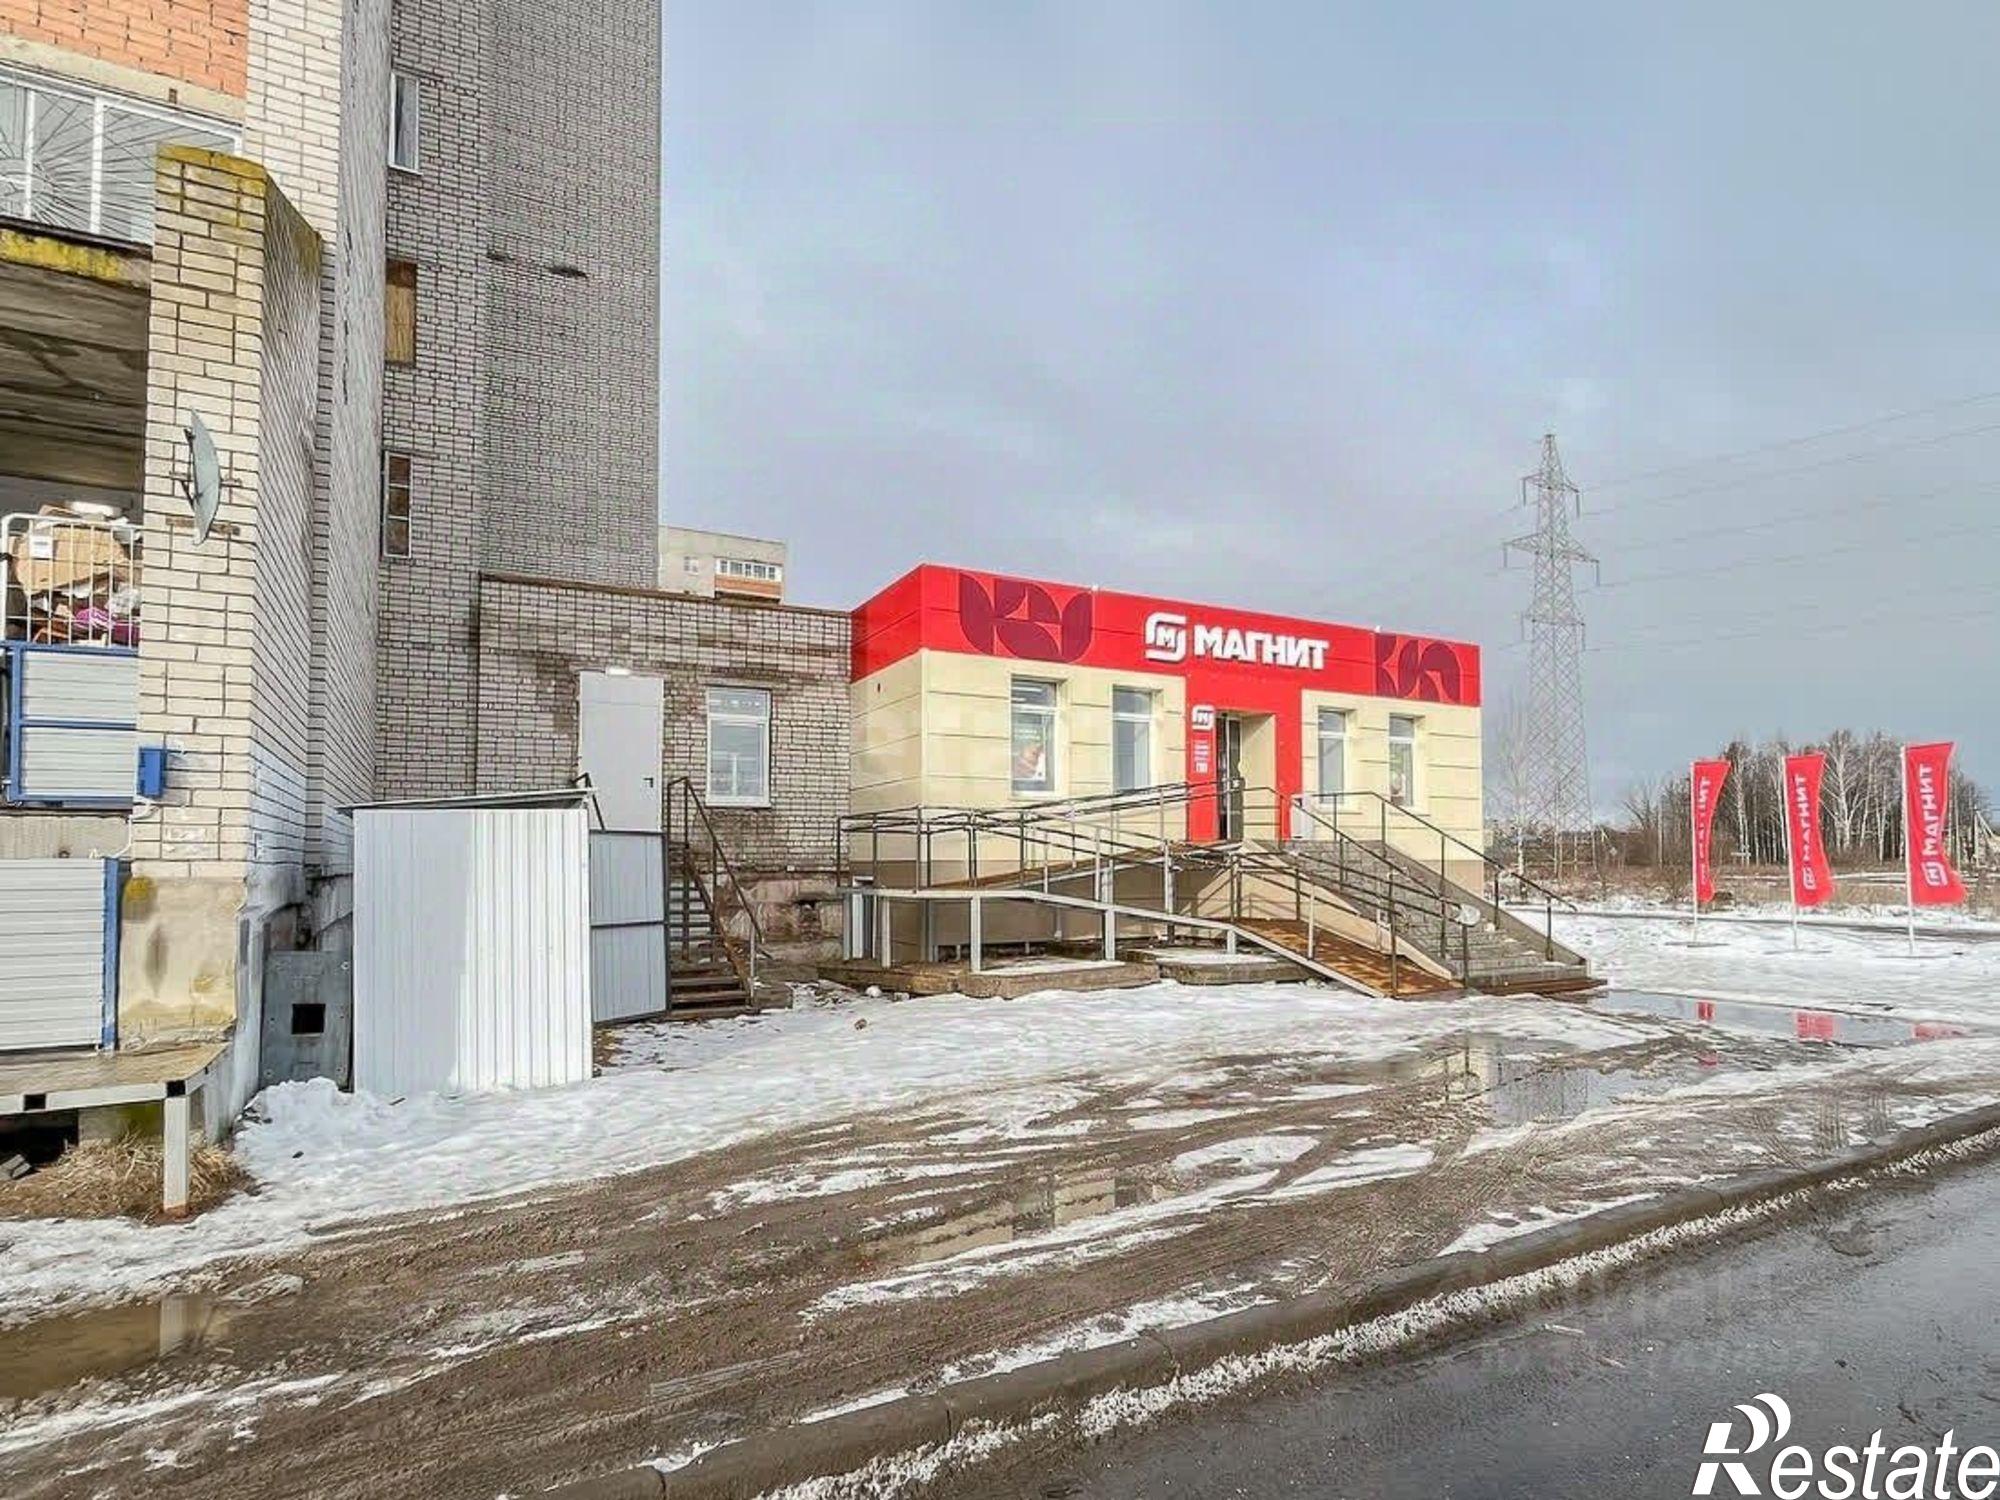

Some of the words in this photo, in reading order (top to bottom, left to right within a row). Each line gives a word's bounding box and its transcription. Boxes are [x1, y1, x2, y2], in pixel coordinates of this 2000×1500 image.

[1193, 623, 1330, 670] МАГНИТ
[1796, 774, 1810, 860] МАГНИТ
[1919, 764, 1943, 857] МАГНИТ
